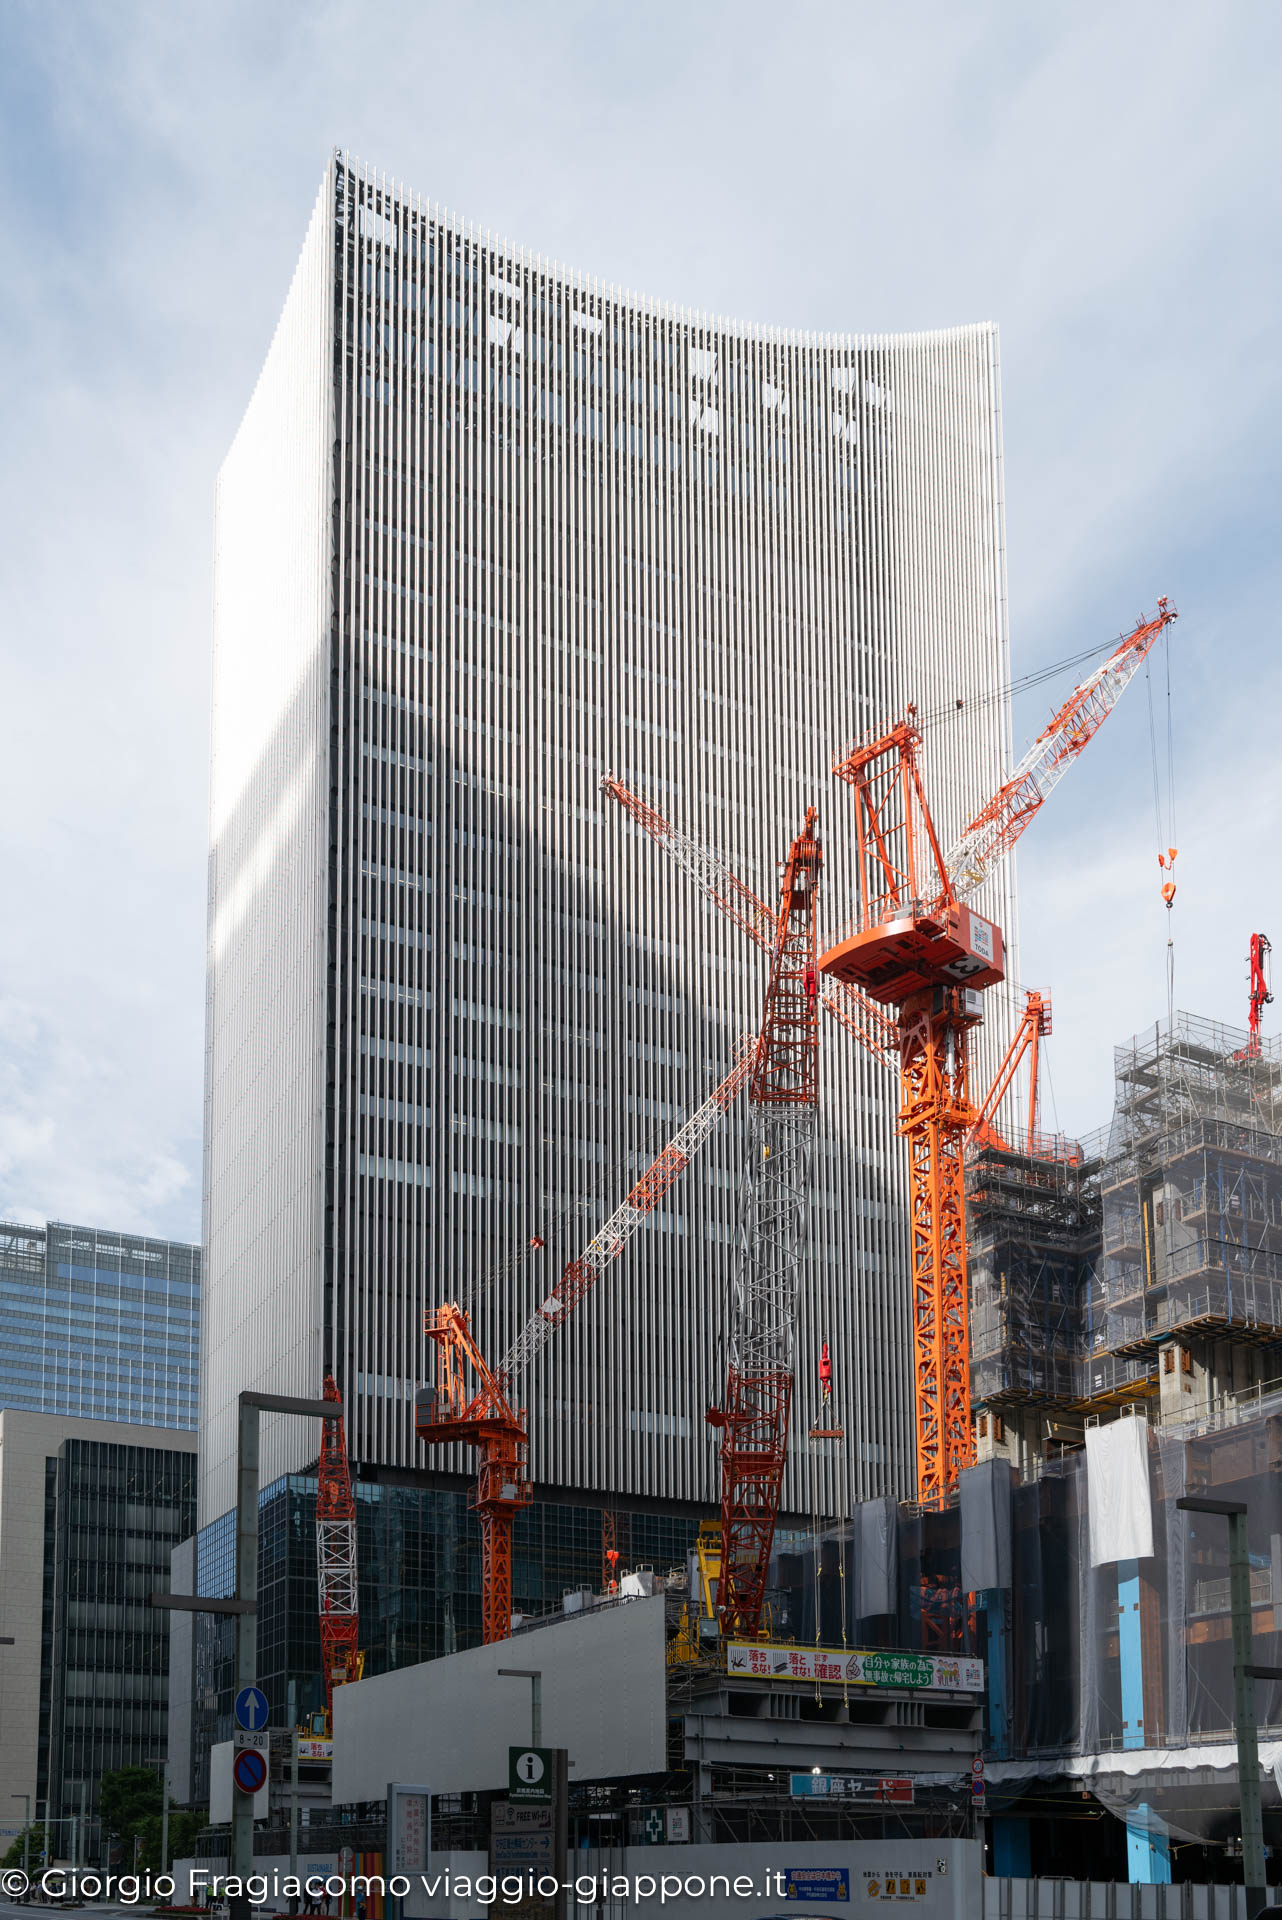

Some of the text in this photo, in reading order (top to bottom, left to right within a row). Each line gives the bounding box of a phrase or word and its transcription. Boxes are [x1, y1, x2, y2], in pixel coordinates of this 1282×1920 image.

[974, 943, 989, 957] TODA
[748, 1649, 767, 1662] 落ち
[788, 1652, 807, 1666] 落と
[751, 1663, 771, 1675] るな!
[864, 1656, 934, 1672] 自分や家族の為に
[791, 1665, 811, 1678] すな!
[814, 1663, 842, 1680] 確認
[811, 1776, 895, 1798] 銀座ヤード
[516, 1810, 531, 1822] FREE
